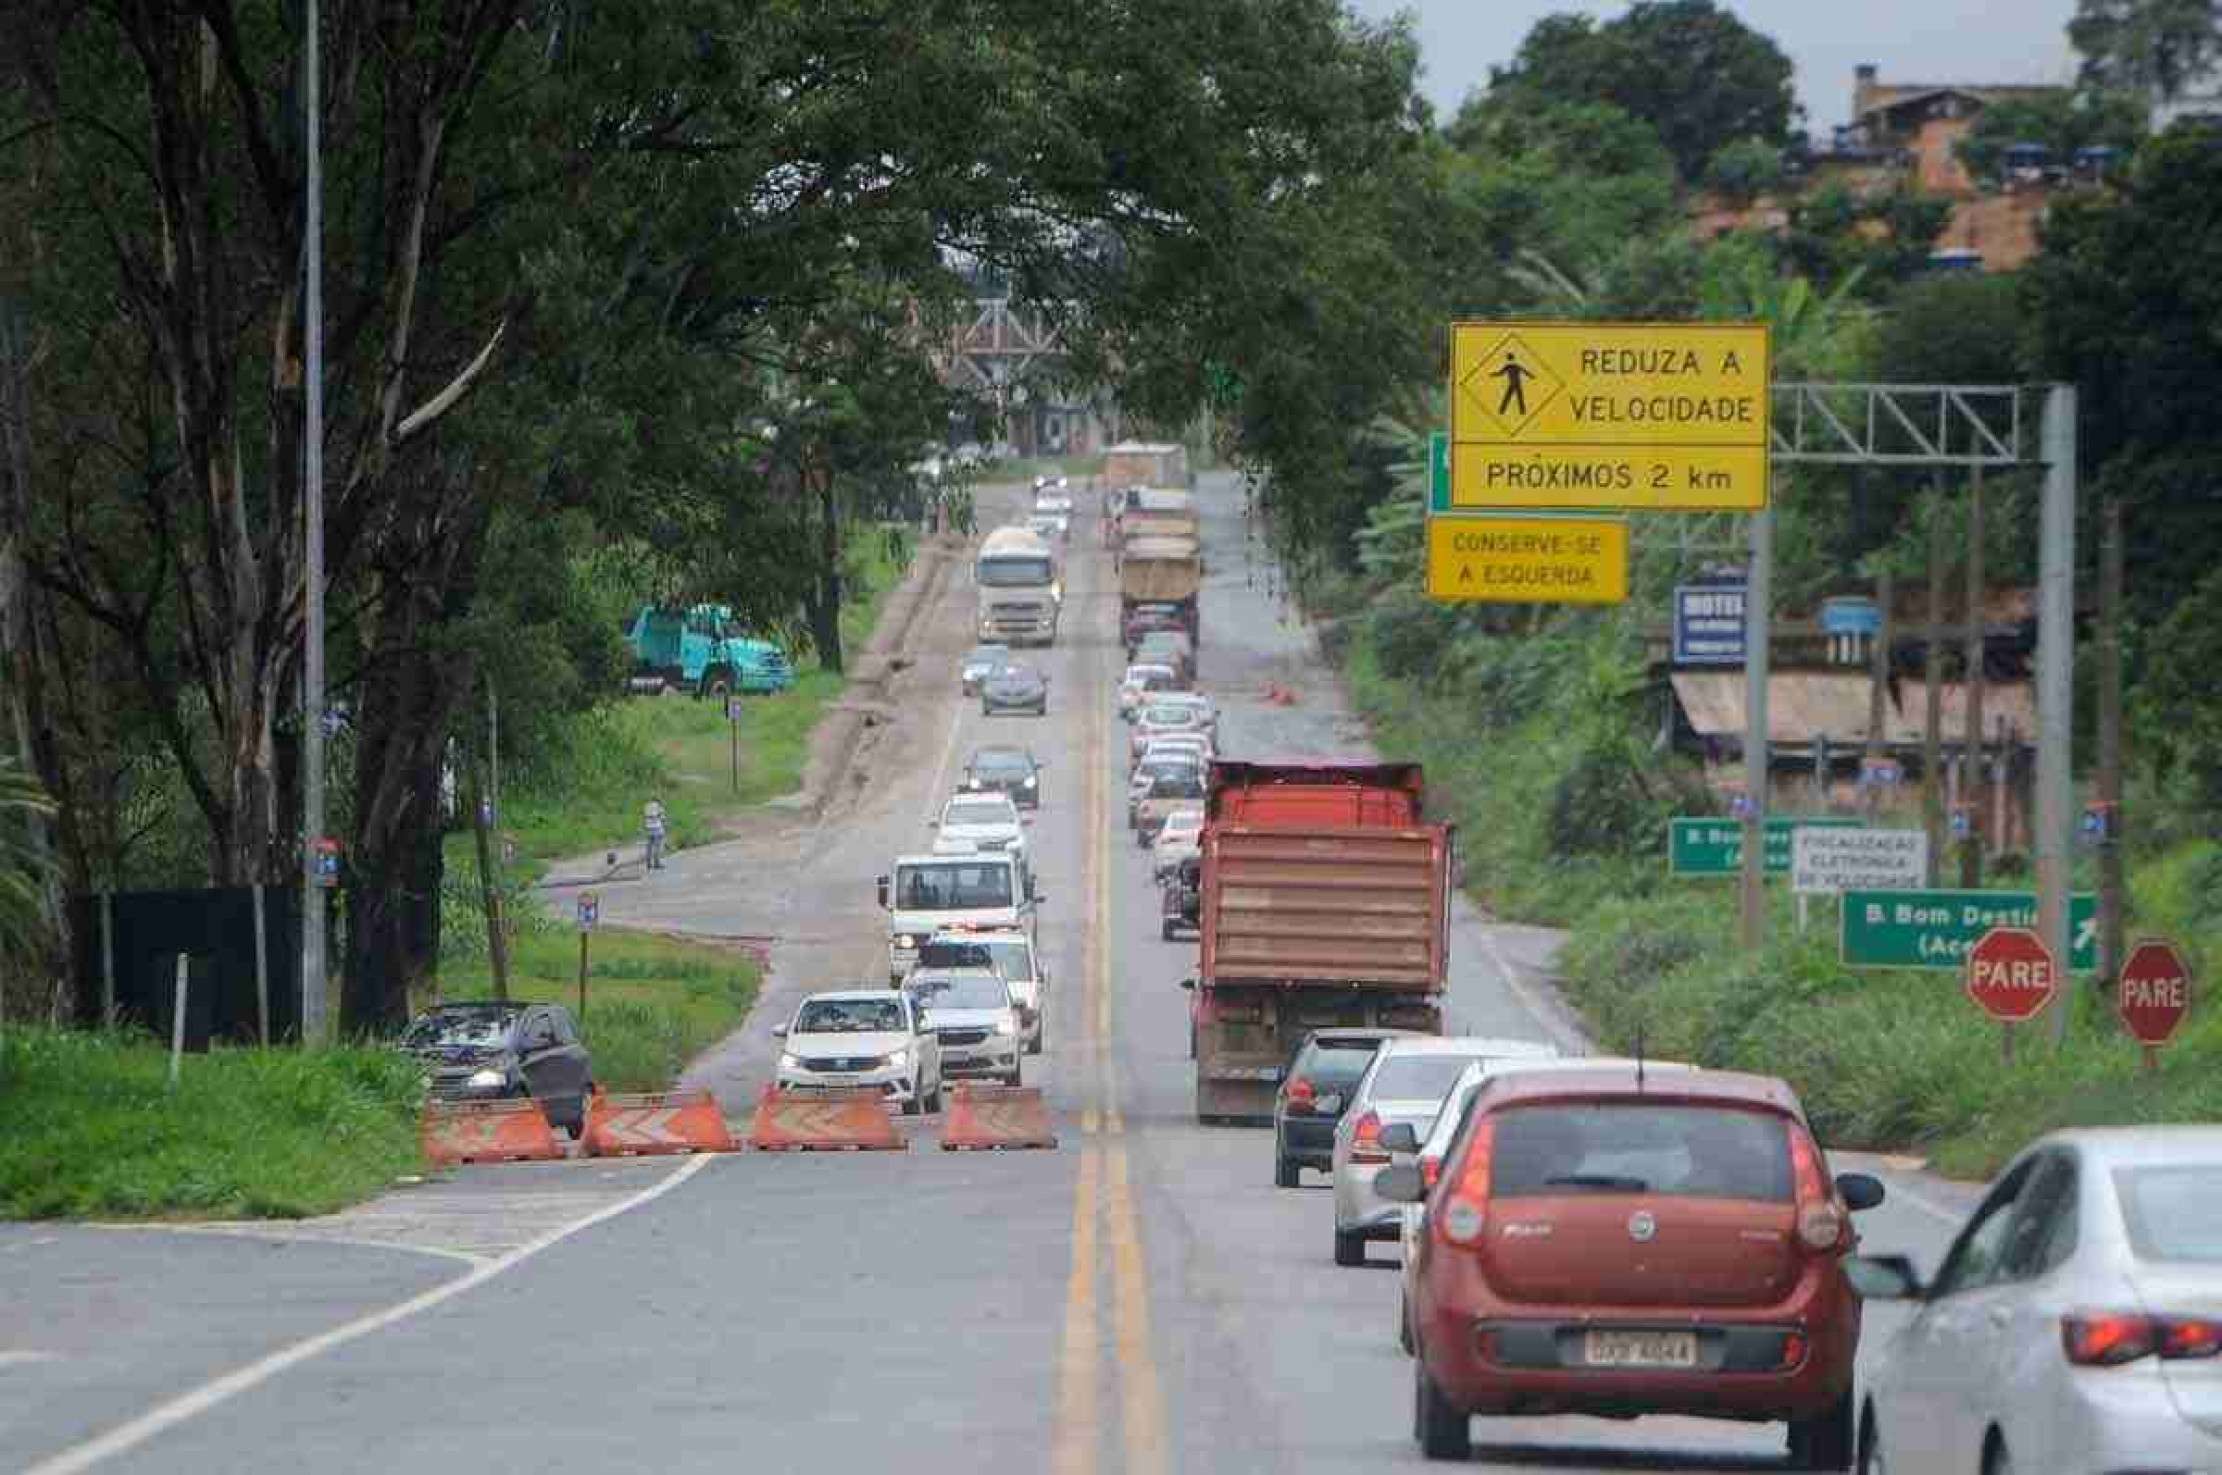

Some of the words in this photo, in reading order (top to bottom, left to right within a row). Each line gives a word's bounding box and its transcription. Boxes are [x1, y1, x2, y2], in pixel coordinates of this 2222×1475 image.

[1581, 350, 1701, 375] REDUZA
[1721, 350, 1741, 374] A
[1569, 397, 1753, 422] VELOCIDADE
[1487, 453, 1632, 489] PRÓXIMOS
[1651, 464, 1670, 488] 2
[1688, 465, 1732, 489] km
[1453, 533, 1601, 553] CONSERVE-SE
[1459, 564, 1473, 582] A
[1895, 904, 1949, 925] Bom
[1972, 961, 2050, 990] PARE
[2122, 977, 2184, 1008] PARE
